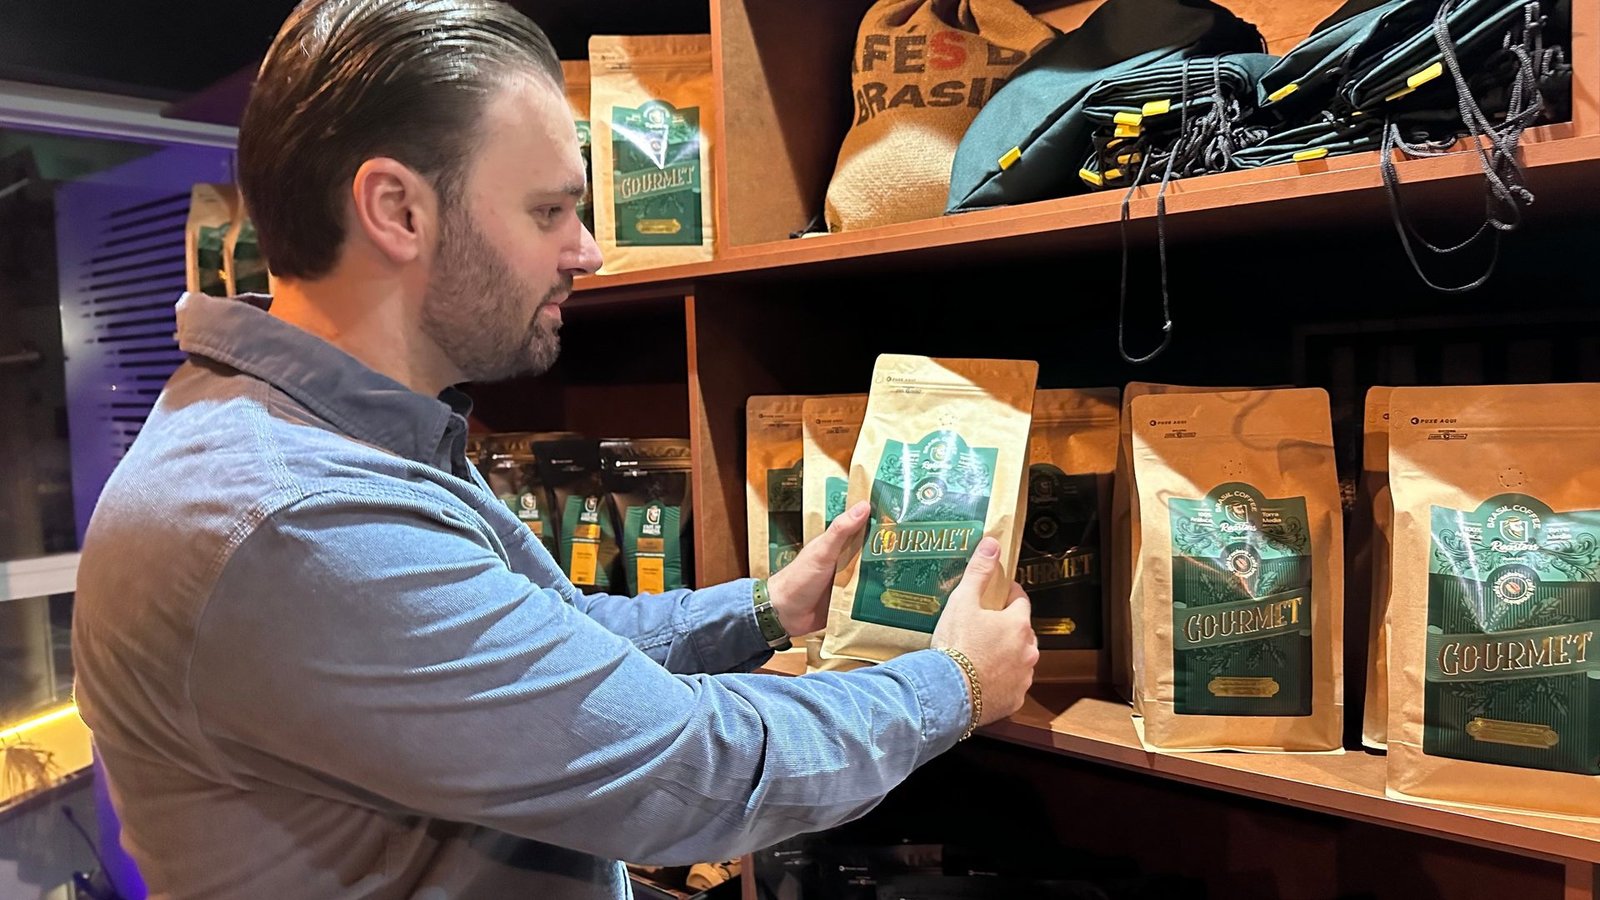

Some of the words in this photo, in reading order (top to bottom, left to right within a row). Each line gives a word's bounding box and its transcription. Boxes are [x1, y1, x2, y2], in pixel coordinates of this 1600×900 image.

[852, 24, 967, 74] FÉS
[621, 165, 695, 199] GOURMET
[1215, 492, 1234, 512] BRASIL
[1233, 490, 1257, 512] COFFEE
[1486, 505, 1512, 528] BRASIL
[1512, 504, 1541, 529] COFFEE
[870, 528, 975, 556] GOURMET
[1490, 540, 1540, 552] Roasters
[1016, 552, 1093, 586] OURMET
[1183, 597, 1303, 643] GOURMET
[1437, 631, 1593, 676] GOURMET
